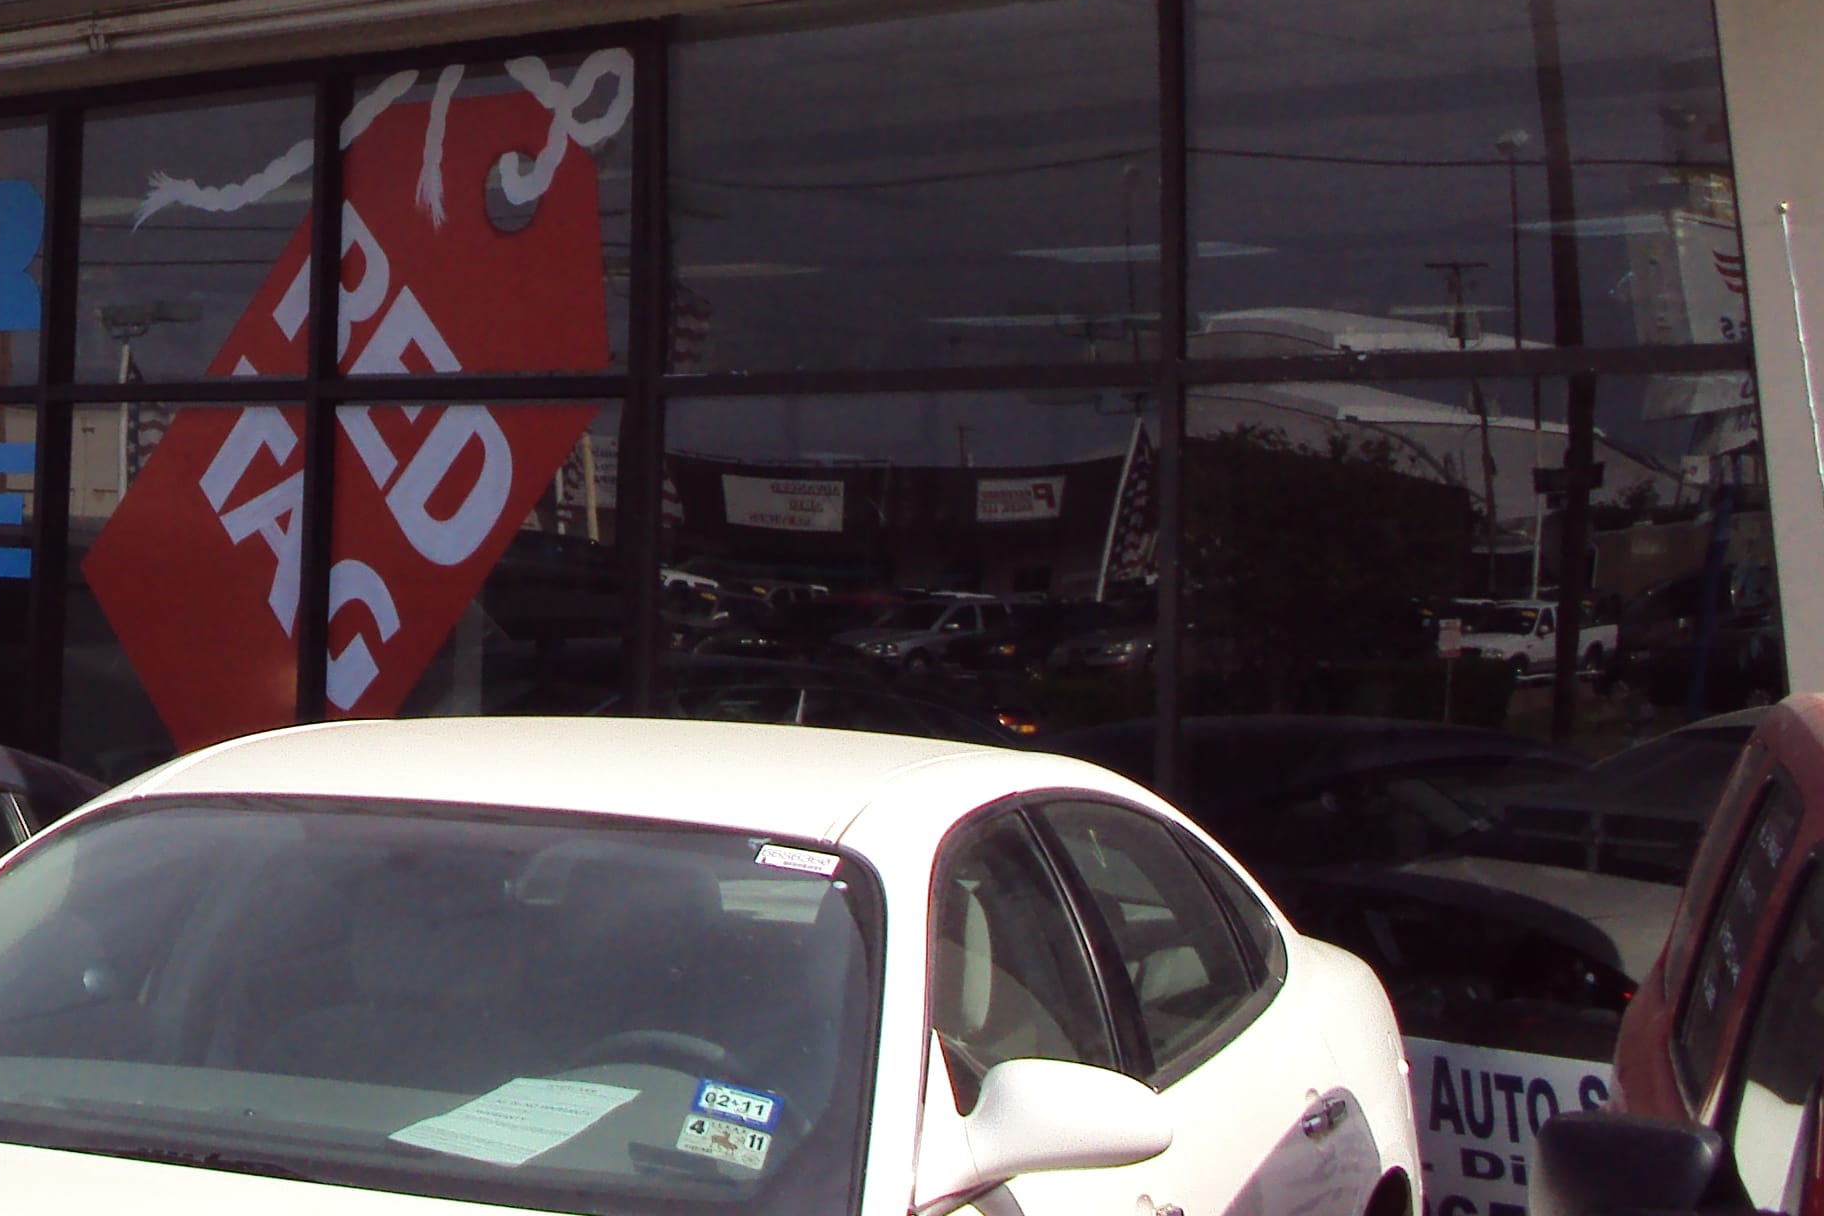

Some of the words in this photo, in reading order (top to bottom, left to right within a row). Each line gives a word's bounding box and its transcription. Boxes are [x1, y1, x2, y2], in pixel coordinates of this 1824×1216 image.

[273, 200, 513, 566] RED
[704, 1091, 730, 1108] 02
[1429, 1055, 1560, 1143] AUTO
[688, 1119, 705, 1135] 4
[748, 1134, 764, 1151] 11
